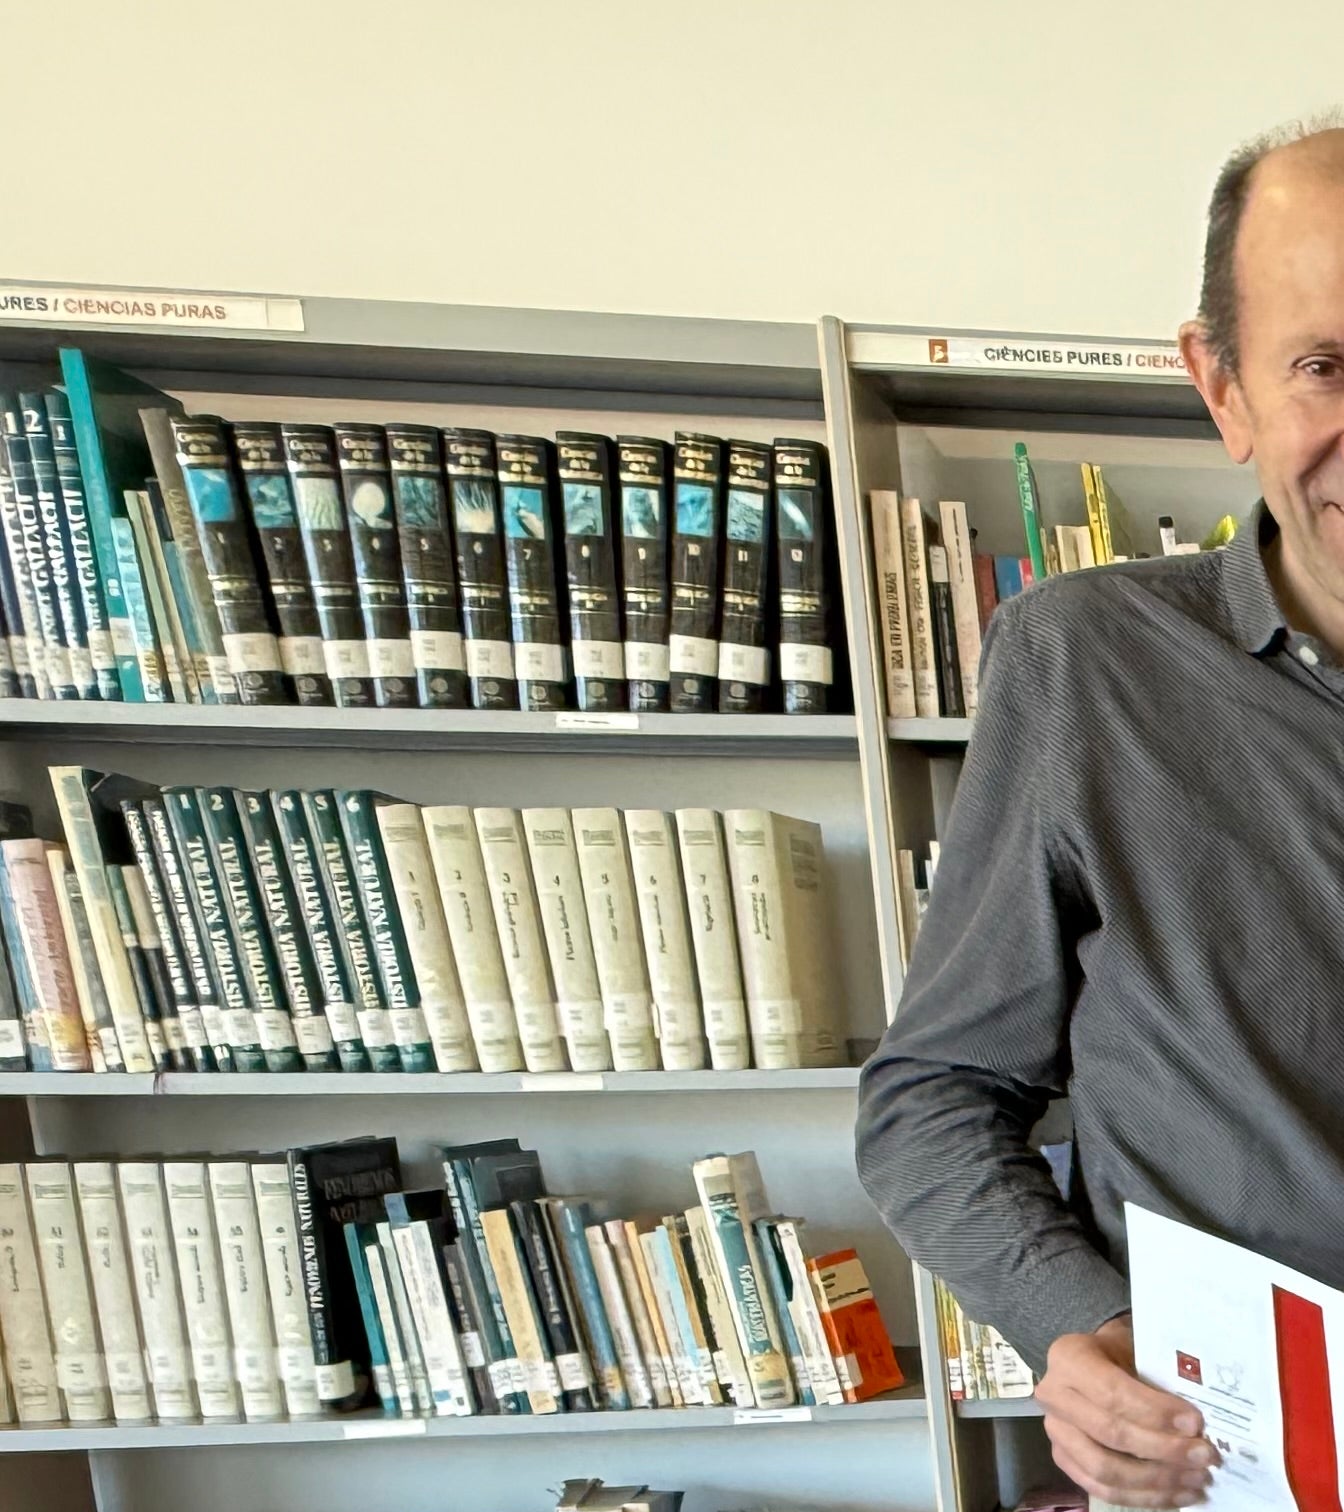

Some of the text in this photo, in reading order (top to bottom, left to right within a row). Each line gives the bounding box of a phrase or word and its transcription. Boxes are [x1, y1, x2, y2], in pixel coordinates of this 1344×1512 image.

[64, 298, 156, 317] CIENCIAS
[161, 303, 227, 320] PURAS
[1067, 351, 1122, 366] PURES
